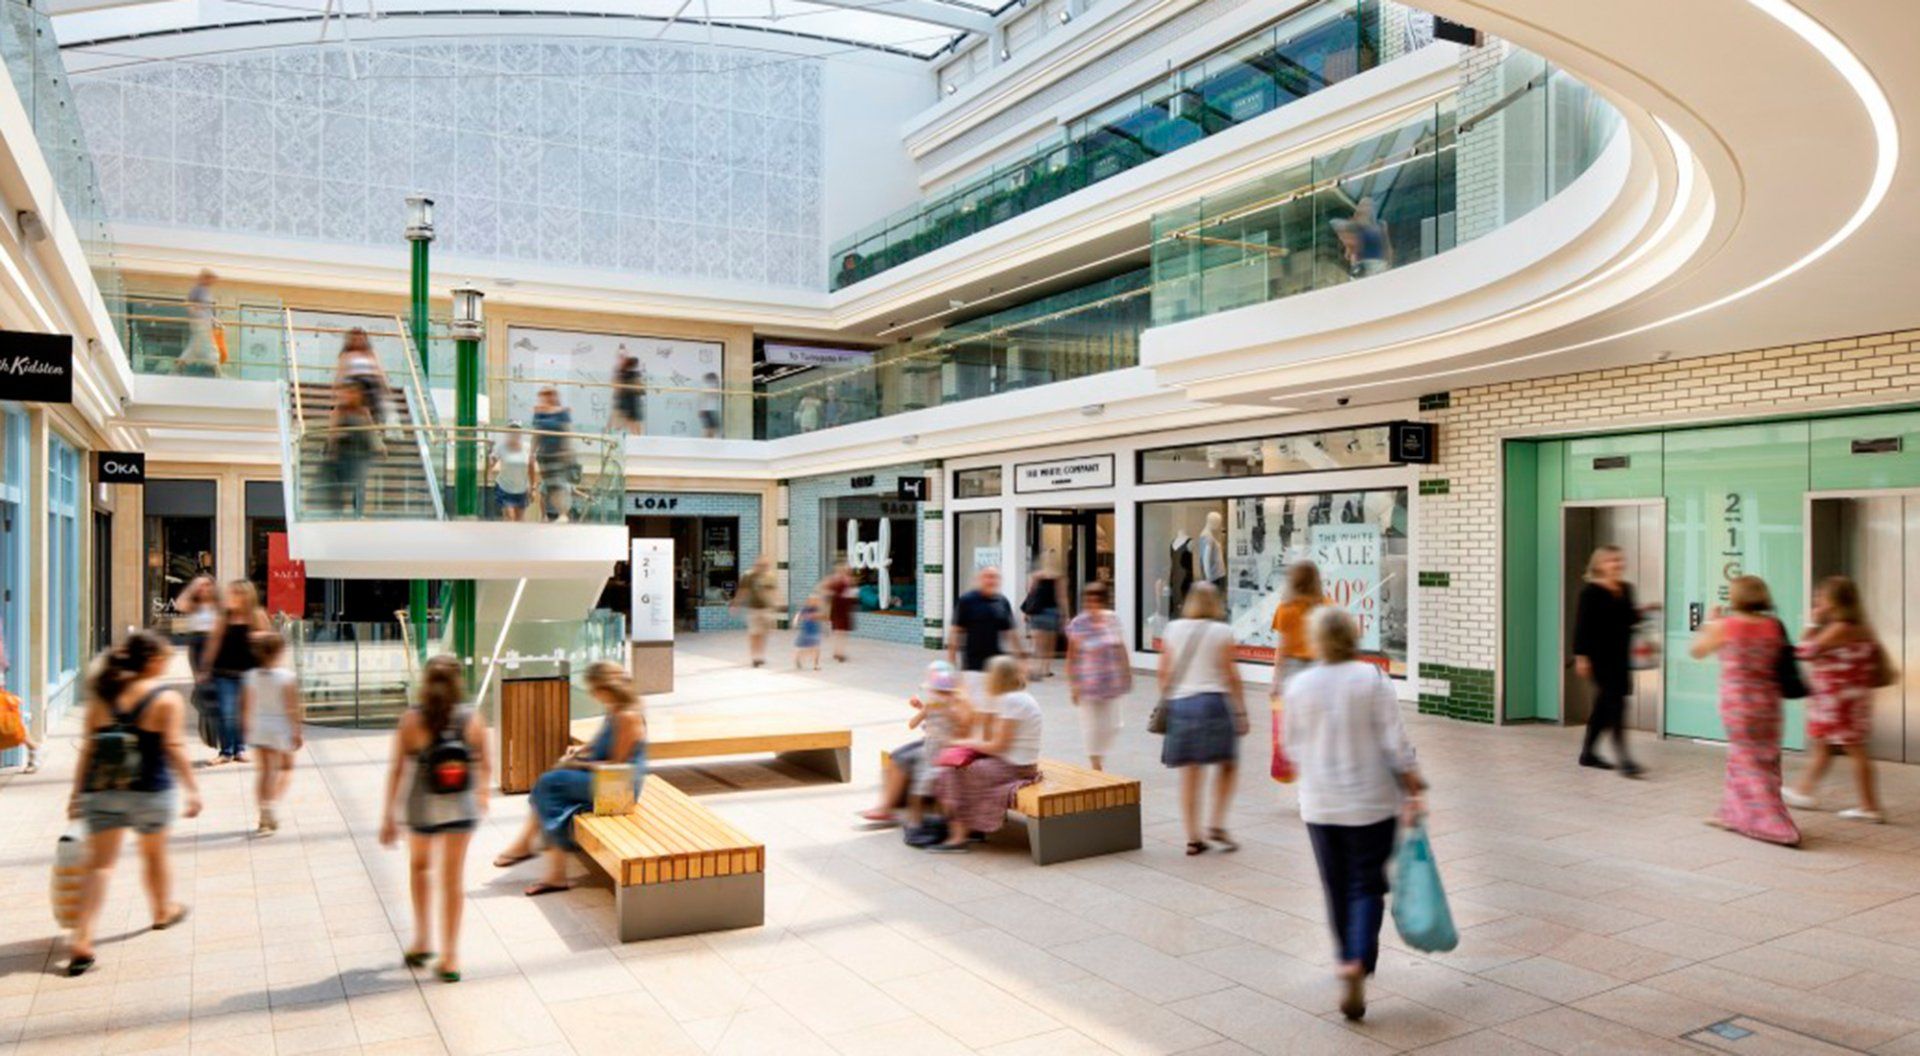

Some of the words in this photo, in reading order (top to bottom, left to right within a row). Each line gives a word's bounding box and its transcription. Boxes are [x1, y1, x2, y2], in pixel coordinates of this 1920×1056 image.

[104, 461, 139, 474] OKA
[1063, 464, 1099, 475] COMPANY
[634, 498, 678, 509] LOAF
[1725, 493, 1741, 513] 2
[1318, 533, 1336, 542] THE
[1341, 532, 1374, 541] WHITE
[1727, 527, 1736, 547] 1
[1318, 545, 1374, 565] SALE
[642, 558, 649, 567] 2
[274, 571, 300, 579] SALE
[1723, 562, 1742, 581] G
